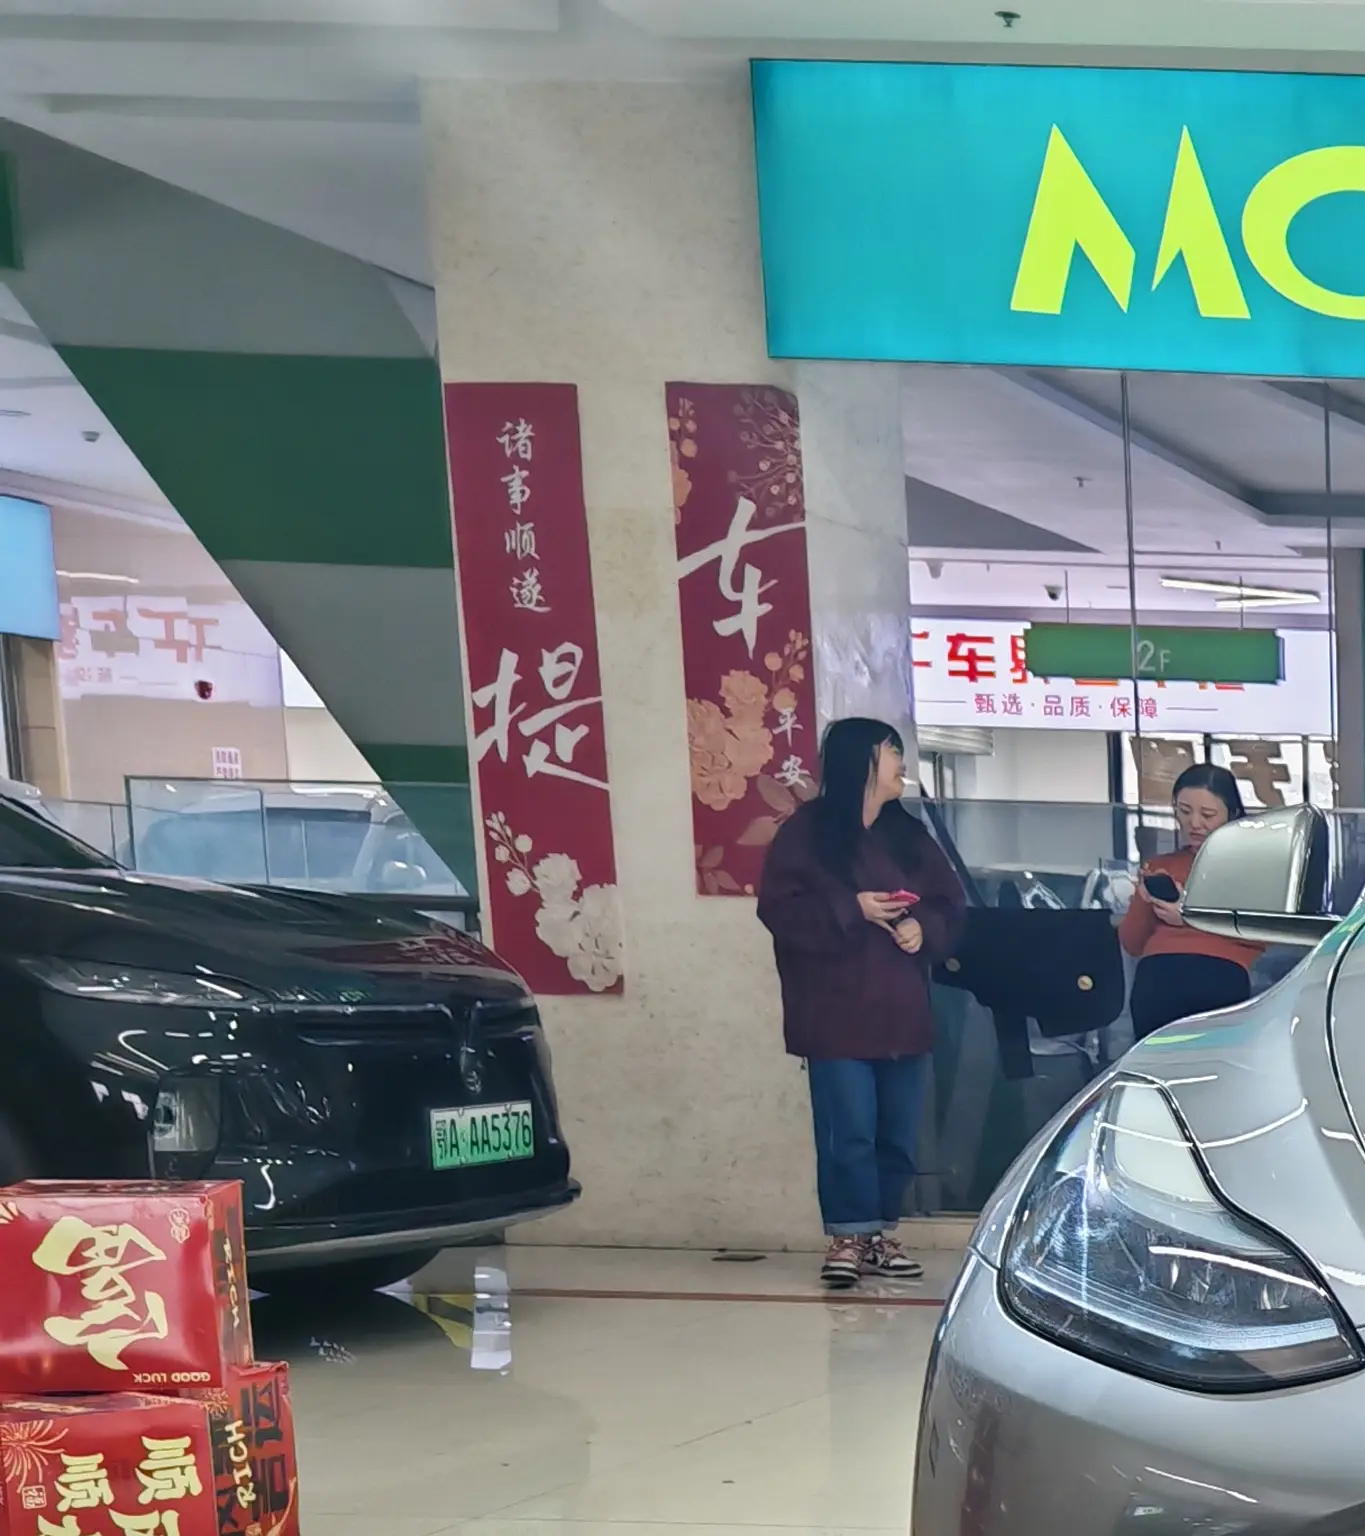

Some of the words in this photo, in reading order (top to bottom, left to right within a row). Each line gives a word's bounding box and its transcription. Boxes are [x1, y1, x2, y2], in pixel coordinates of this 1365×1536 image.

[496, 417, 552, 613] 诸事顺遂
[678, 496, 806, 660] 车
[1136, 639, 1172, 673] 2F
[472, 640, 611, 792] 提
[772, 706, 809, 788] 平安
[469, 1109, 532, 1156] AA5376
[31, 1216, 168, 1371] 富
[133, 1372, 168, 1383] LUCK
[171, 1371, 211, 1383] GOOD
[224, 1419, 257, 1510] RICH
